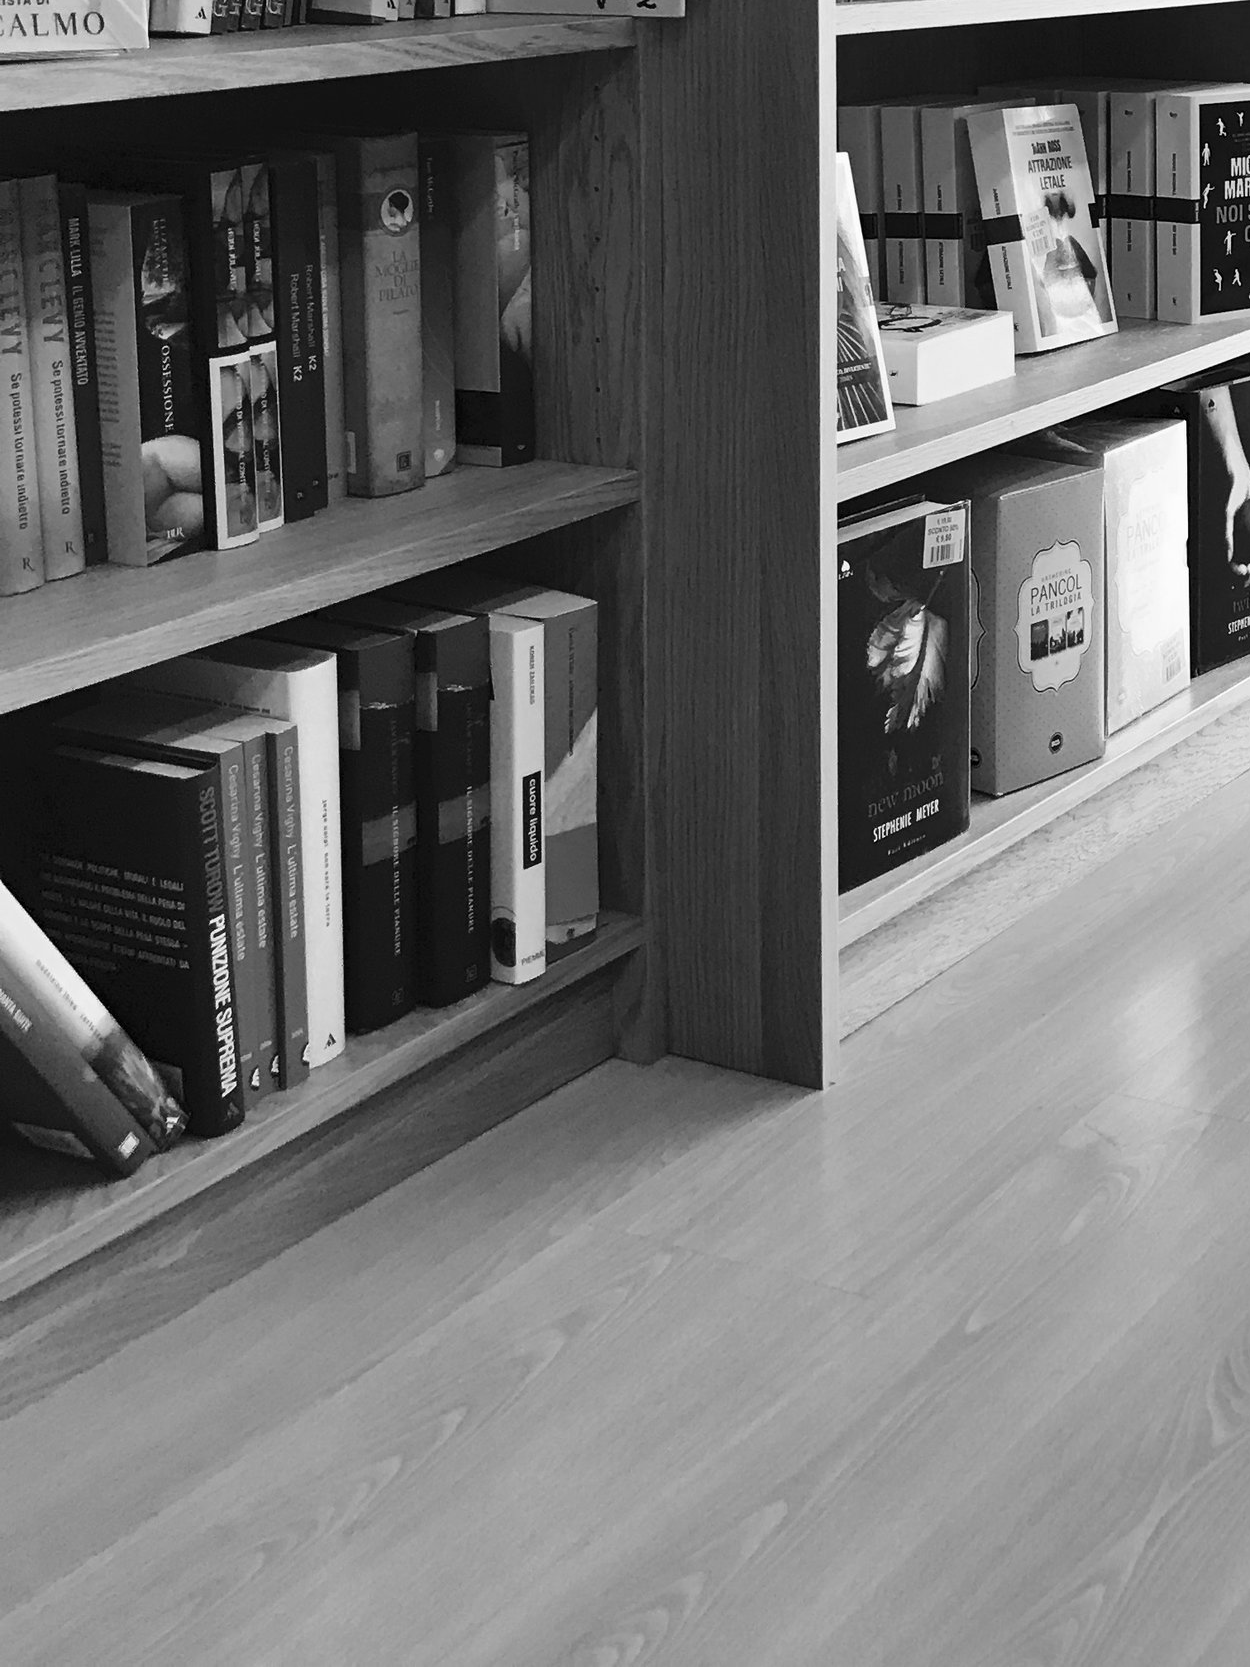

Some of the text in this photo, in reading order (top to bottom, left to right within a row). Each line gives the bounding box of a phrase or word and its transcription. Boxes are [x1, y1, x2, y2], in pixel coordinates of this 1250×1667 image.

[1028, 156, 1072, 173] ATTRAZIONE
[1040, 175, 1066, 190] LETALE
[68, 218, 81, 247] MARK
[1216, 204, 1243, 224] NOI
[70, 249, 82, 276] LILLA
[289, 274, 304, 382] Robert Marshall K2
[305, 264, 318, 372] Robert Marshall K2
[74, 331, 88, 385] AVVENTATO
[160, 344, 174, 432] OSSESSIONE
[1031, 574, 1082, 605] PANCOL
[1031, 592, 1082, 616] LA TRILOGIA
[868, 772, 944, 817] new moon
[527, 779, 539, 861] cuore liquido
[873, 799, 939, 842] STEPHENIE MEYER
[250, 754, 268, 948] Cesarina Vighy L'ultima estate
[391, 806, 402, 956] IL SIGNORE DELLE PIANURE
[199, 786, 239, 1097] SCOTT TUROW PUNIZIONE SUPREMA
